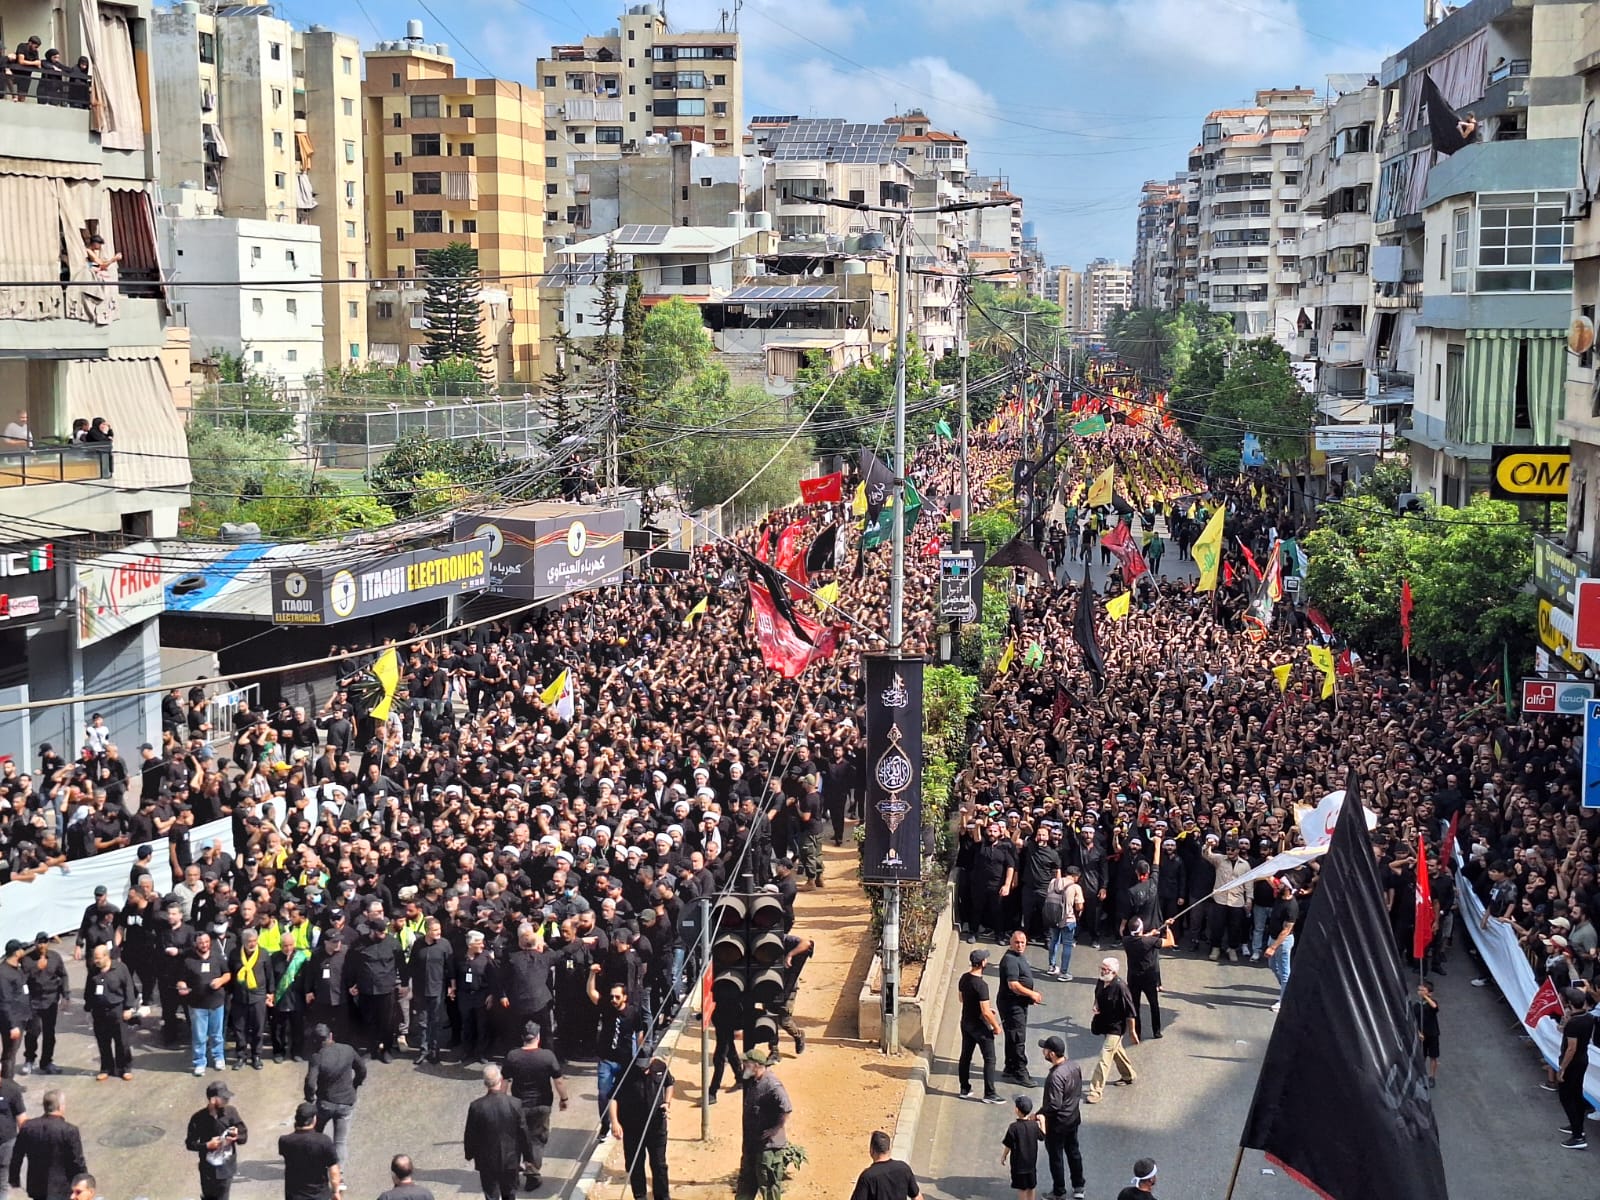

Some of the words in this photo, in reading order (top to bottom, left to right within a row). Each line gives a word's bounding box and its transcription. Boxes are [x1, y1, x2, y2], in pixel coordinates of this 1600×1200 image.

[581, 555, 606, 577] كهرباء
[120, 556, 161, 599] FRIGO
[361, 566, 406, 602] ITAOUI
[407, 550, 484, 592] ELECTRONICS
[282, 600, 312, 611] ITAOUI
[275, 613, 321, 623] ELECTRONICS
[1526, 694, 1546, 705] alfa
